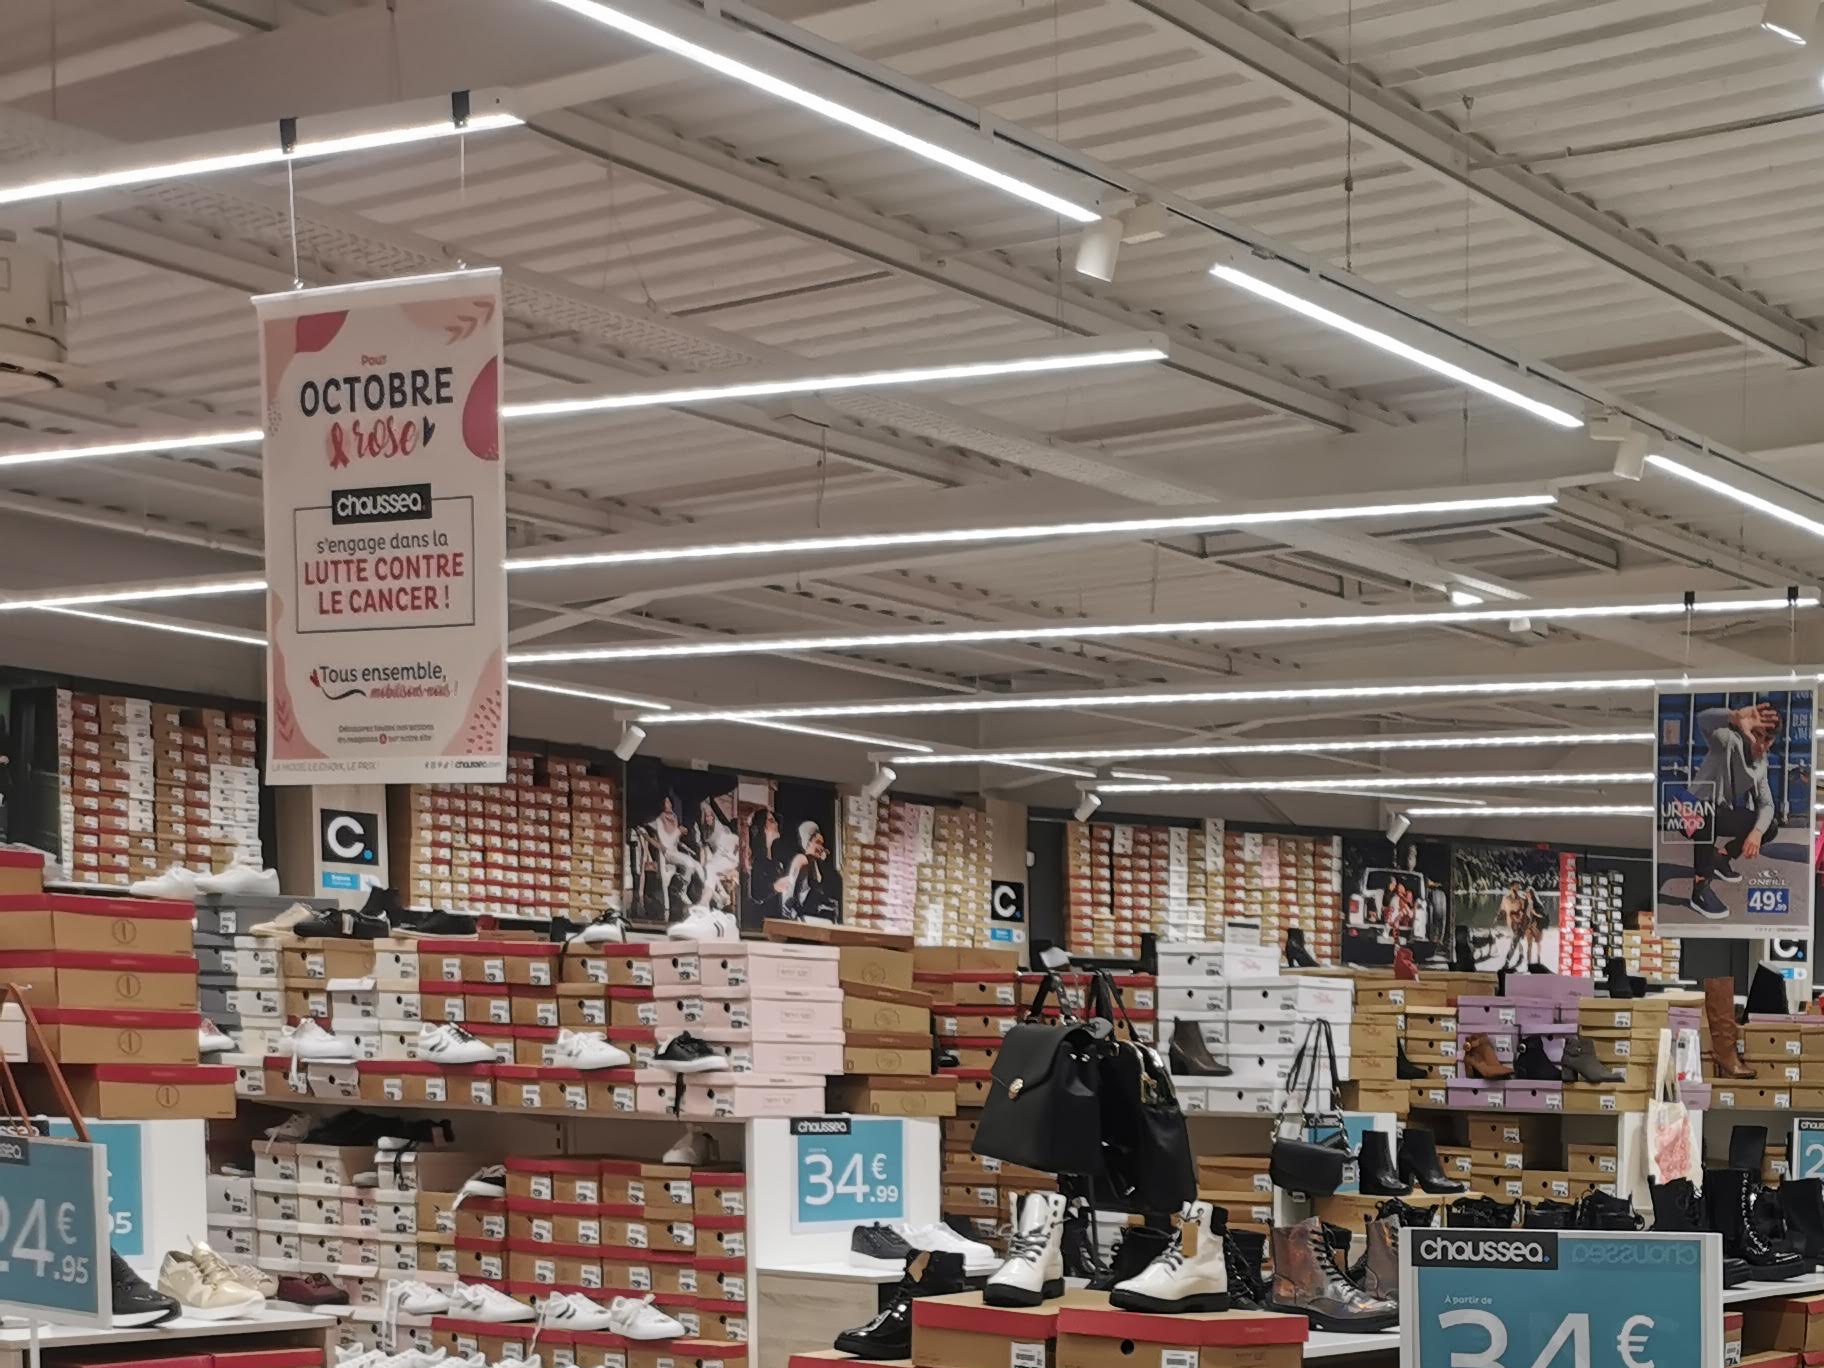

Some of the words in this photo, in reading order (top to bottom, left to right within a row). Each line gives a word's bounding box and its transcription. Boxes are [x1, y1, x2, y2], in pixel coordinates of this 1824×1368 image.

[300, 367, 454, 417] OCTOBRE
[353, 416, 418, 459] rose
[317, 536, 385, 555] s'engage
[390, 533, 428, 550] dans
[433, 529, 448, 546] la
[304, 558, 368, 585] LUTTE
[374, 552, 464, 580] CONTRE
[319, 591, 343, 615] LE
[350, 586, 438, 613] CANCER
[319, 665, 358, 683] Tous
[362, 661, 447, 682] ensemble,
[1661, 801, 1716, 818] URBAN
[1666, 818, 1706, 831] MOOD
[1750, 891, 1774, 910] 49
[805, 1153, 870, 1205] 34
[872, 1153, 887, 1180] €
[58, 1202, 77, 1244] €
[1453, 1296, 1478, 1305] partir
[1481, 1296, 1492, 1304] de
